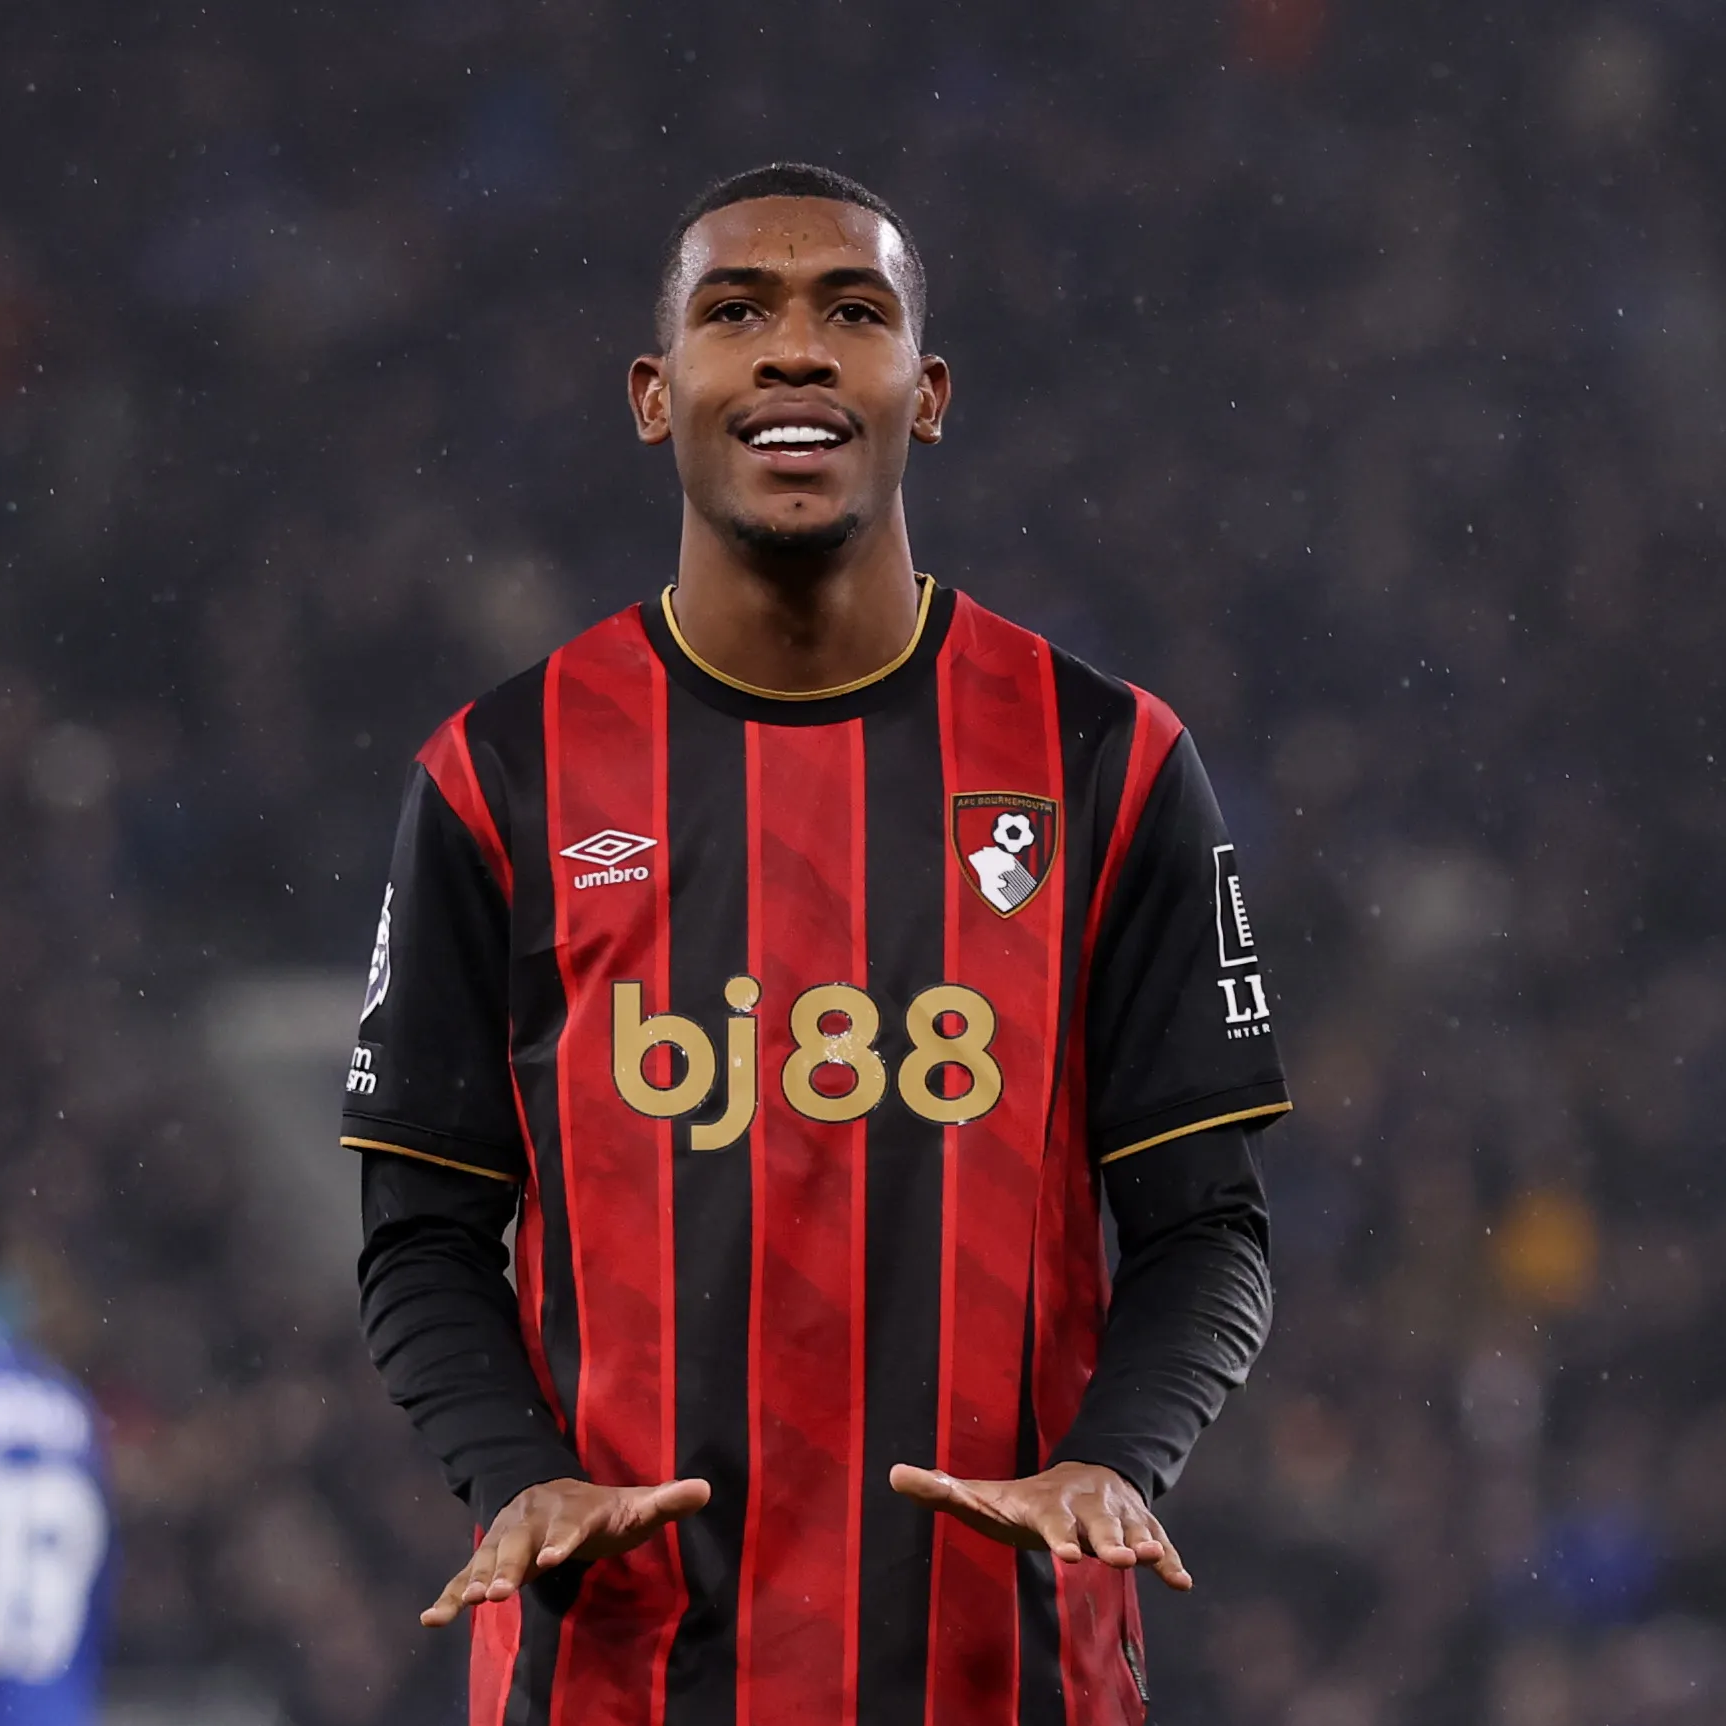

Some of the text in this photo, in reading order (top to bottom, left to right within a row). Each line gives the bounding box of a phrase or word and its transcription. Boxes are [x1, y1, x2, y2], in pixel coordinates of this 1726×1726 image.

[978, 795, 1052, 812] BOURNEMOUTH
[574, 866, 648, 889] umbro
[612, 974, 1005, 1152] bj88
